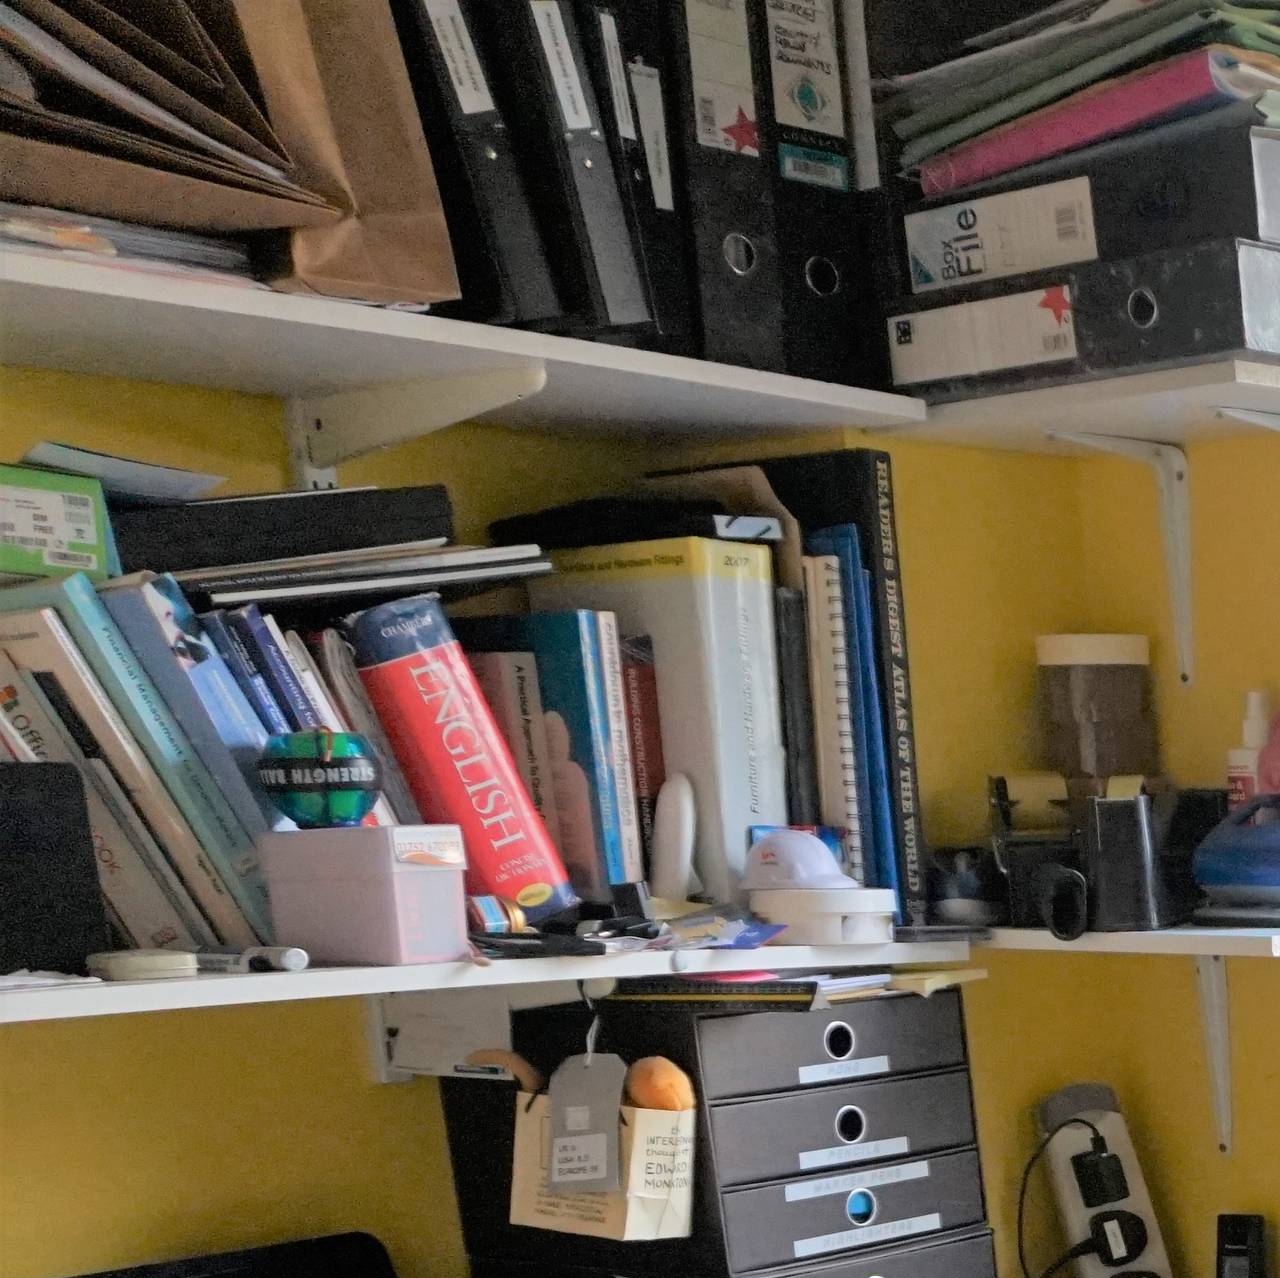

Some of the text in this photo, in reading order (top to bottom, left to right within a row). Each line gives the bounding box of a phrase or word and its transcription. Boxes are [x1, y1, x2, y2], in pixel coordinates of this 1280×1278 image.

[941, 239, 956, 281] Box
[952, 207, 984, 278] File
[723, 555, 749, 567] 2007
[885, 578, 903, 657] DIGEST
[101, 623, 138, 684] Financial
[133, 681, 184, 756] Management
[266, 642, 307, 711] Accounting
[513, 675, 531, 717] Practical
[624, 667, 641, 715] BUILDING
[890, 661, 908, 734] ATLAS
[291, 766, 376, 786] STRENGTH
[408, 655, 528, 852] ENGLISH
[630, 716, 650, 798] CONSTRUCTION
[897, 735, 910, 763] OF
[747, 753, 761, 815] Furniture
[899, 763, 915, 814] THE
[902, 816, 921, 892] WORLD
